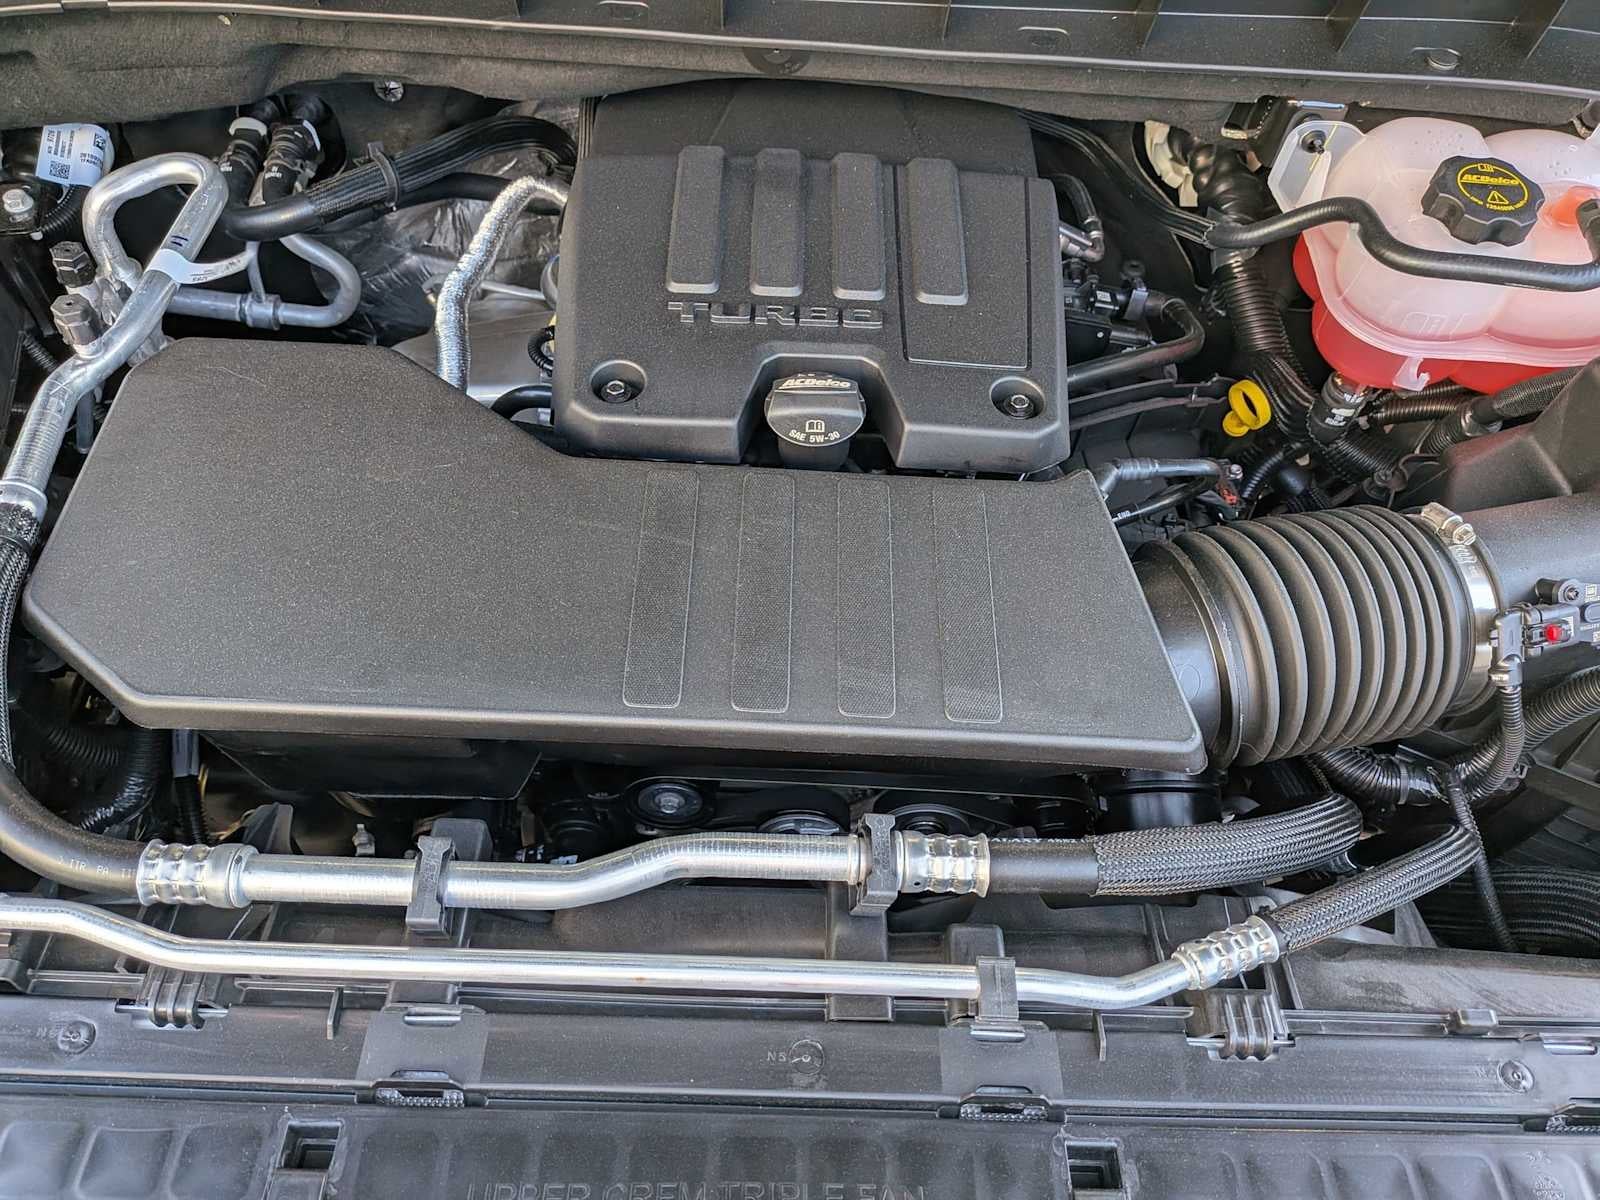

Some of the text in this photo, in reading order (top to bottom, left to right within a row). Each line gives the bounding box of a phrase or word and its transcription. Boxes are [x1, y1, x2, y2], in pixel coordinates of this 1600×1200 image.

[1461, 174, 1520, 186] ACDelco
[667, 301, 884, 329] TURBO
[778, 378, 852, 390] ACDelco
[788, 429, 841, 443] SAE 5W-30
[466, 1183, 592, 1200] UPPER
[719, 1182, 844, 1200] TRIPLE
